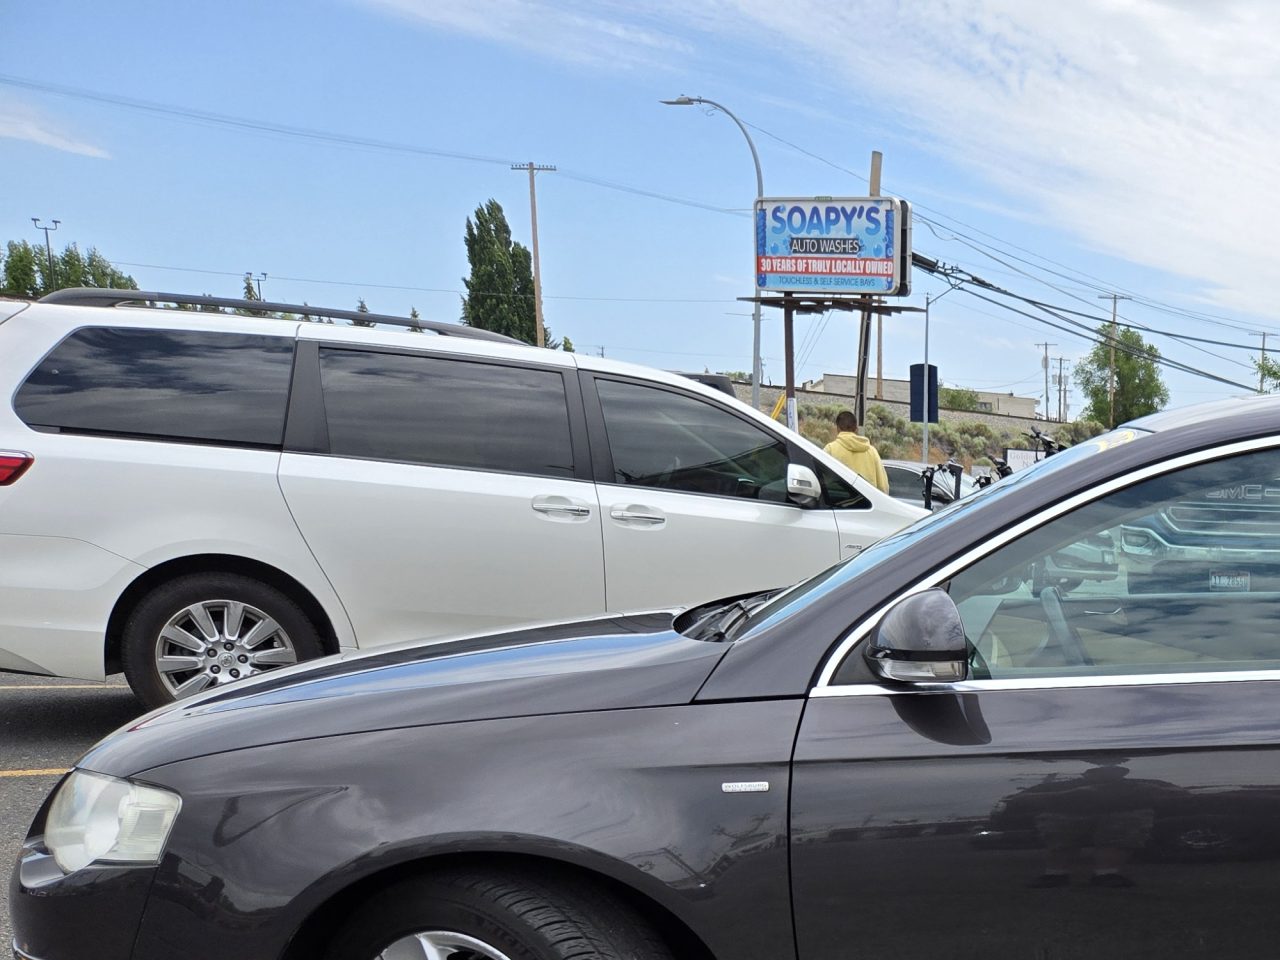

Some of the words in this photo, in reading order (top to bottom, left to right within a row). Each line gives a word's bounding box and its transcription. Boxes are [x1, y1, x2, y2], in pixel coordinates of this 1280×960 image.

[771, 205, 881, 236] SOAPY'S
[791, 239, 818, 252] AUTO
[819, 239, 859, 253] WASHES
[761, 258, 771, 271] 30
[772, 259, 796, 273] YEARS
[797, 259, 807, 273] OF
[808, 259, 830, 273] TRULY
[832, 260, 865, 274] LOCALLY
[865, 260, 893, 275] OWNED
[779, 276, 813, 285] TOUCHLESS
[814, 277, 819, 286] &
[820, 277, 833, 286] SELF
[833, 278, 858, 287] SERVICE
[860, 278, 876, 287] BAYS
